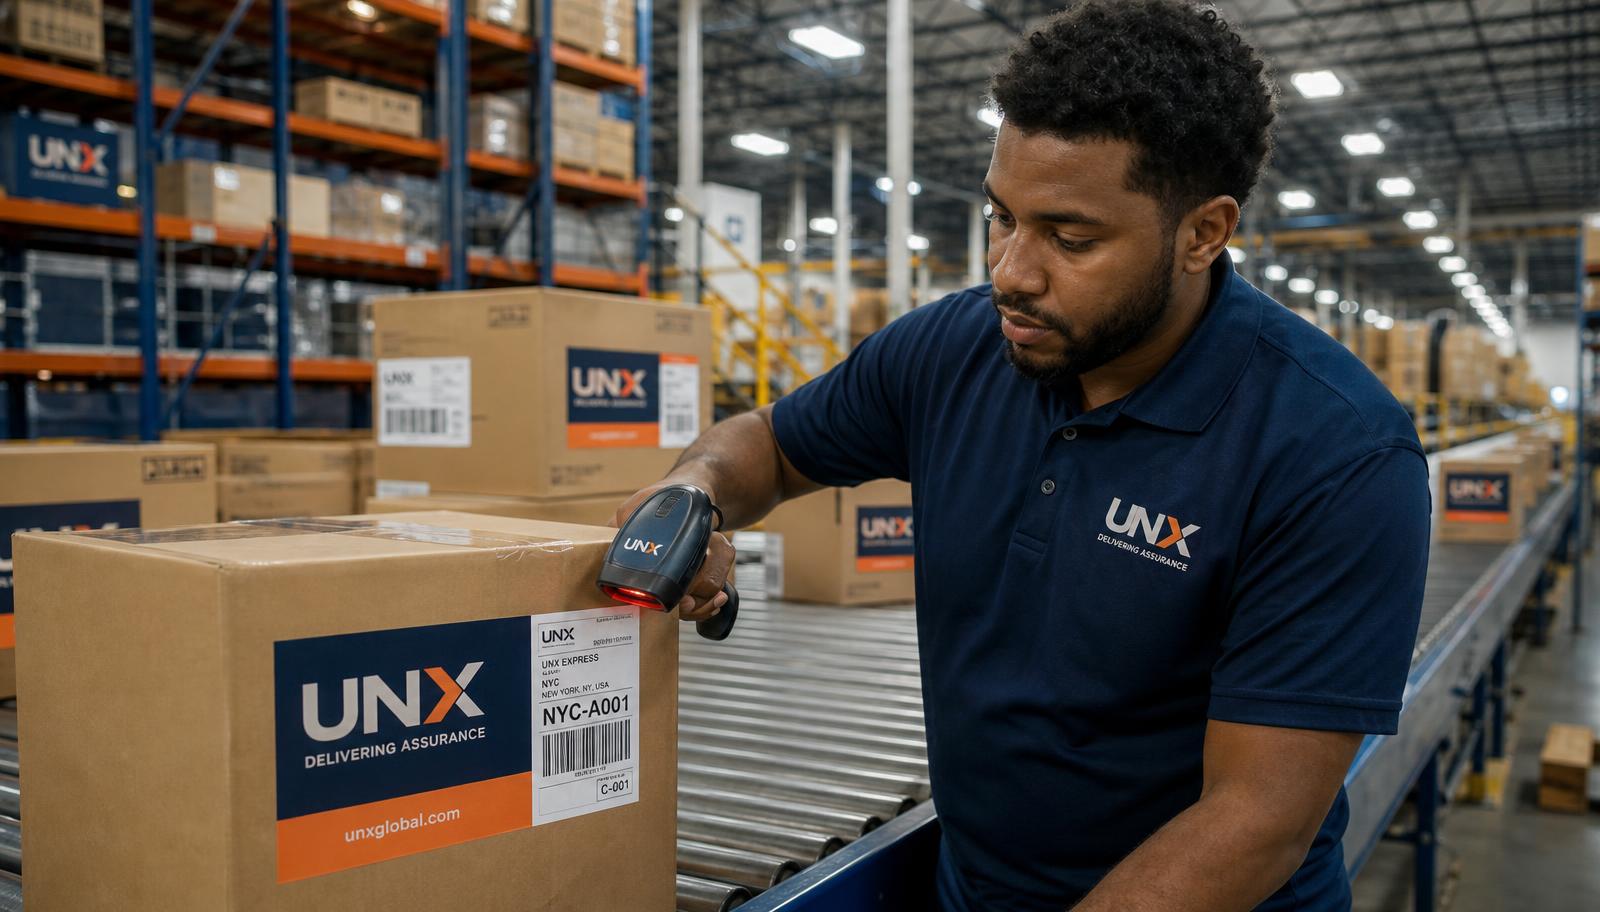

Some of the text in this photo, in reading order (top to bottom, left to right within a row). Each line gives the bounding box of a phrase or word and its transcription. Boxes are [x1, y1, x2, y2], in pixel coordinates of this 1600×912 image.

[28, 134, 109, 177] UNX
[571, 366, 647, 399] UNX
[861, 516, 913, 538] UNX
[1105, 497, 1201, 558] UNX
[623, 538, 663, 556] UNX
[1097, 533, 1188, 572] DELIVERING ASSURANCE
[542, 627, 575, 643] UNX
[541, 653, 599, 669] UNX EXPRESS
[541, 678, 559, 688] NYC
[541, 691, 558, 699] NEW
[595, 681, 610, 690] USA
[302, 661, 485, 742] UNX
[543, 694, 630, 726] NYC-A001
[304, 726, 486, 769] DELIVERING ASSURANCE
[601, 779, 629, 795] C-001
[344, 807, 460, 843] unxglobal.com
